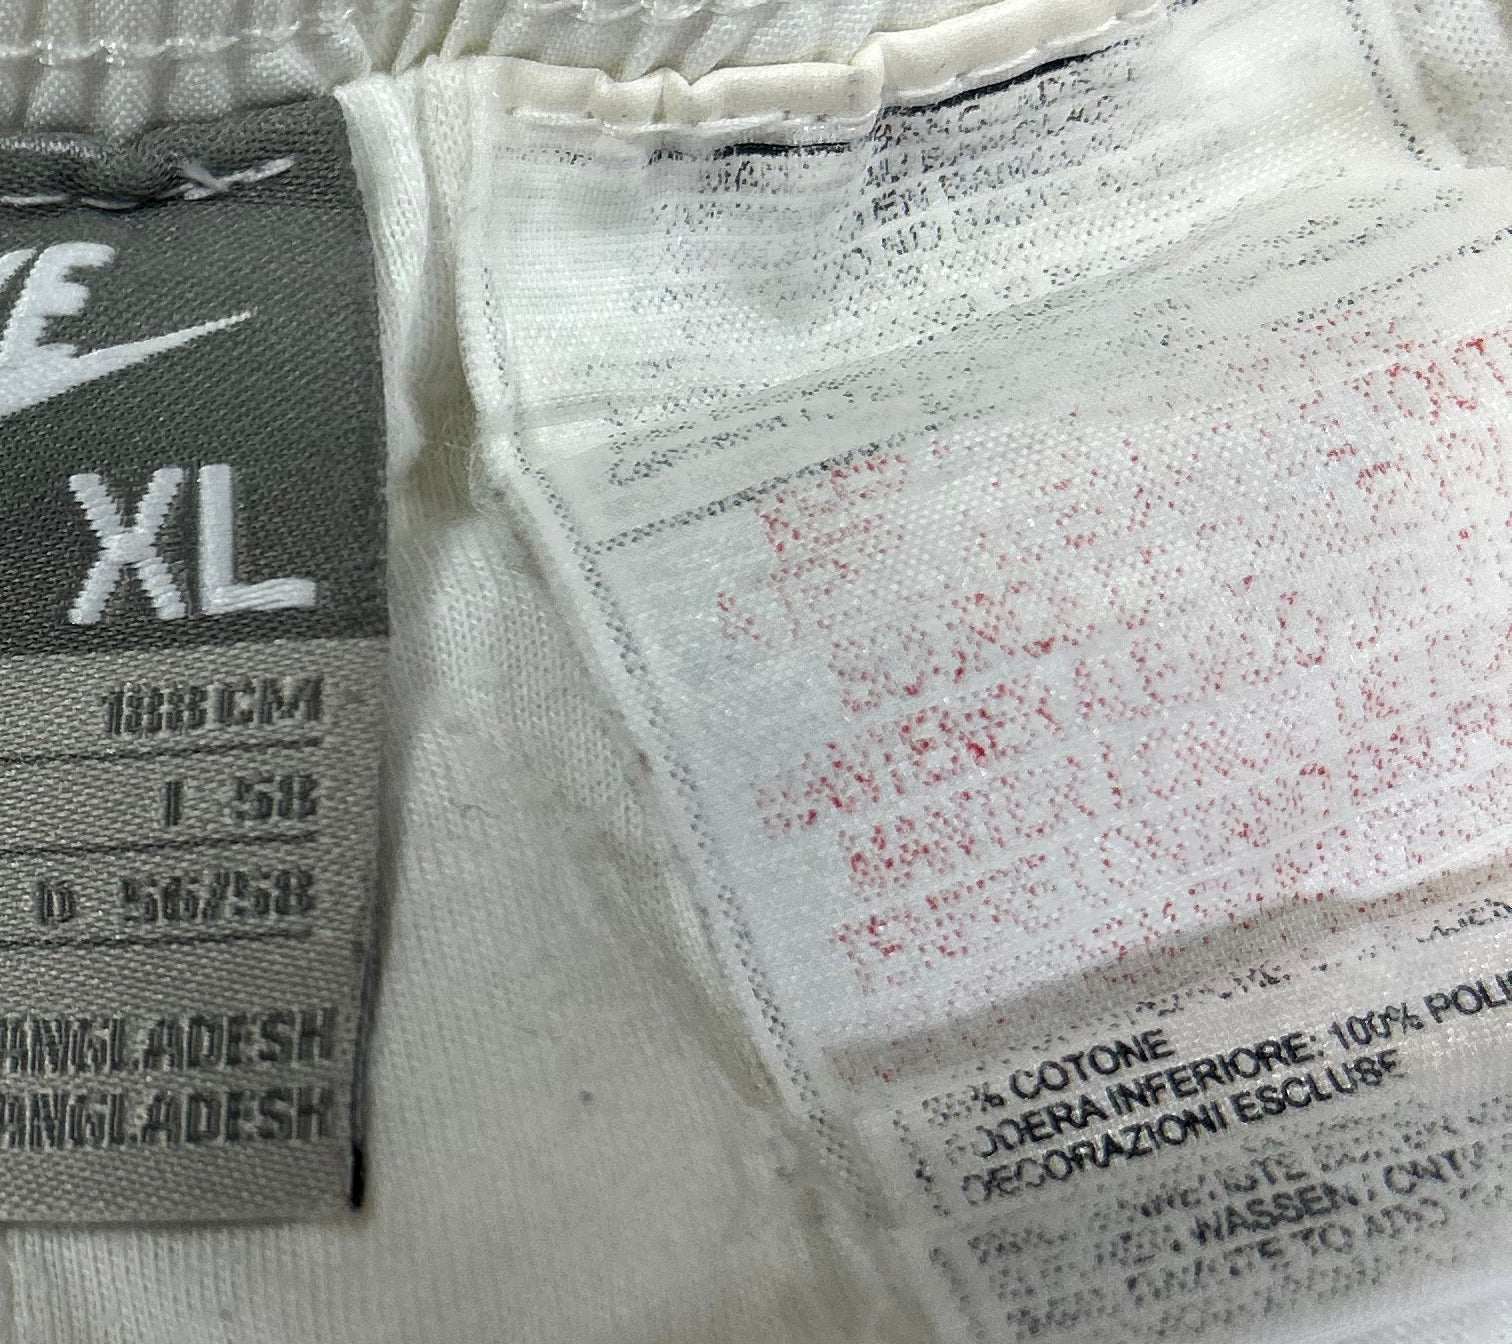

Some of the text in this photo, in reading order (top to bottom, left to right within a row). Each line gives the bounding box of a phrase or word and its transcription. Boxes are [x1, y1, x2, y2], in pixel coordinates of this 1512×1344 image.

[68, 464, 316, 624] XL
[235, 773, 317, 821] 58
[118, 867, 314, 924] 56/58
[1008, 1028, 1175, 1100] COTONE
[1105, 1031, 1326, 1116] INFERIORE:
[1328, 1000, 1424, 1050] 100%
